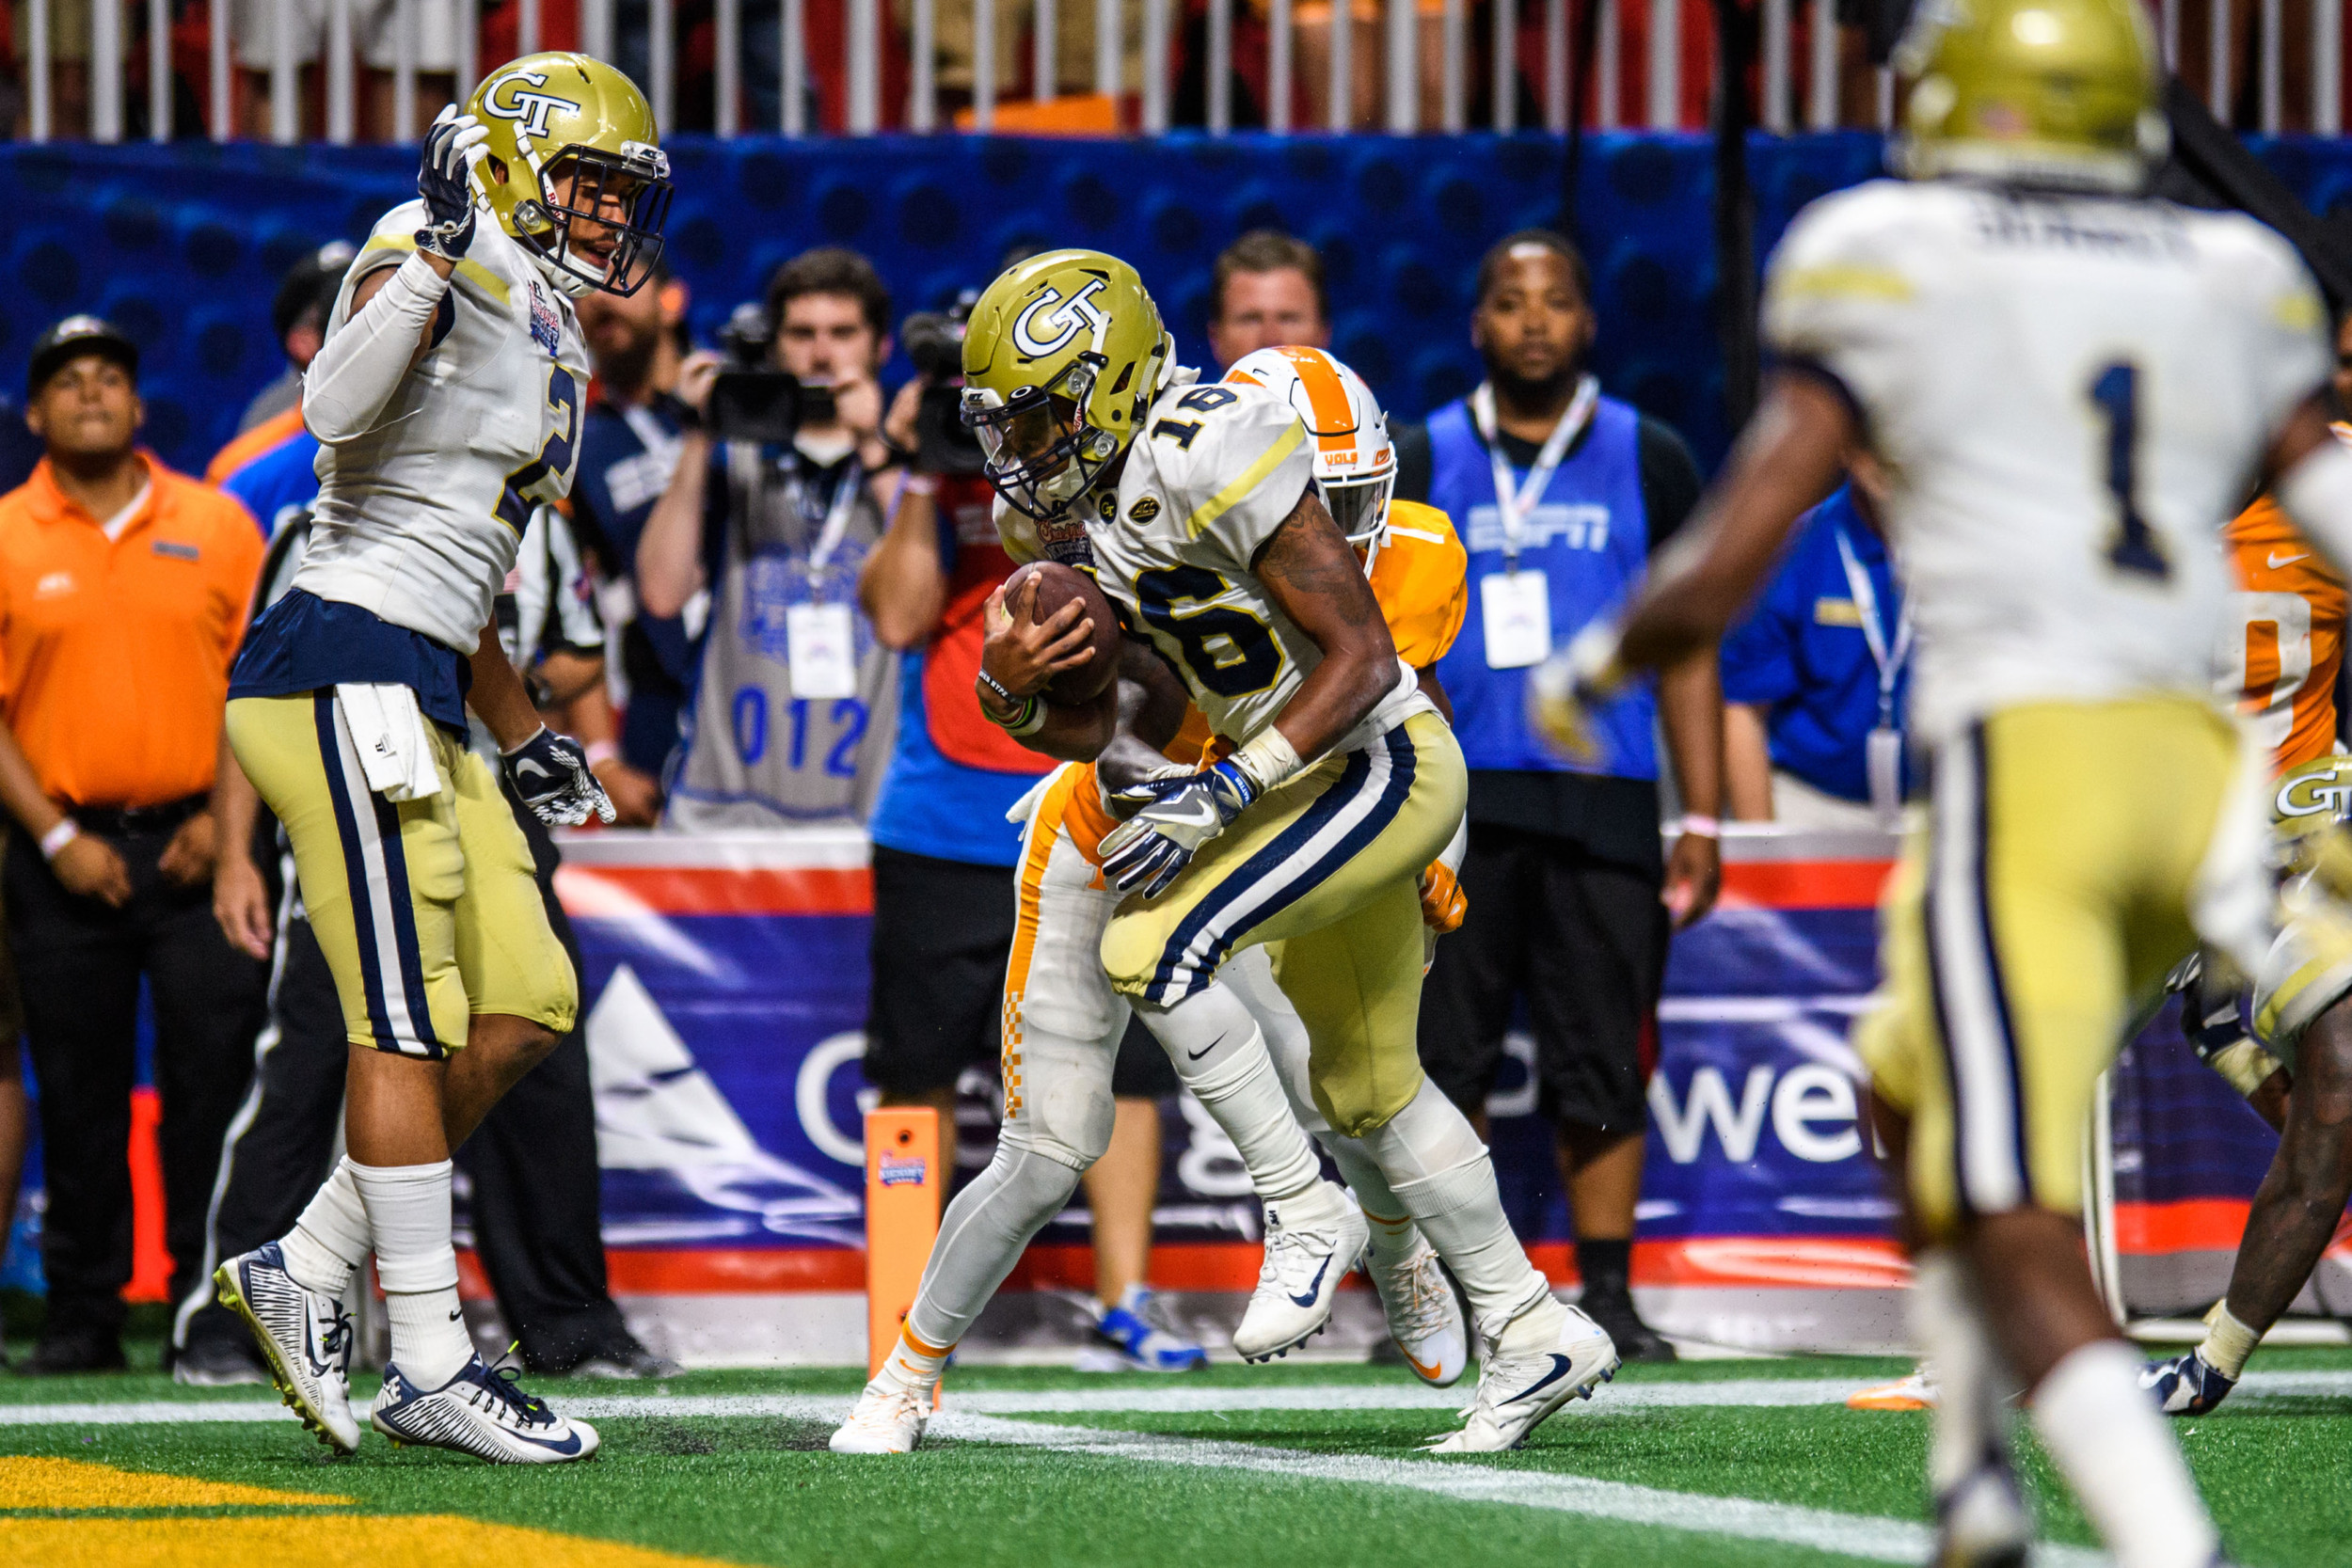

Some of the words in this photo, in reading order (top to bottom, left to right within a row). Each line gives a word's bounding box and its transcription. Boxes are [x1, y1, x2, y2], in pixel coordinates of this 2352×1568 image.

[484, 71, 580, 138] GT
[1012, 278, 1112, 358] GT
[491, 361, 577, 544] 2
[1150, 387, 1241, 452] 16
[1324, 451, 1359, 464] VOLS
[2085, 359, 2173, 581] 1
[1466, 501, 1611, 554] ESPN
[1077, 564, 1286, 699] 6
[731, 685, 871, 781] 012
